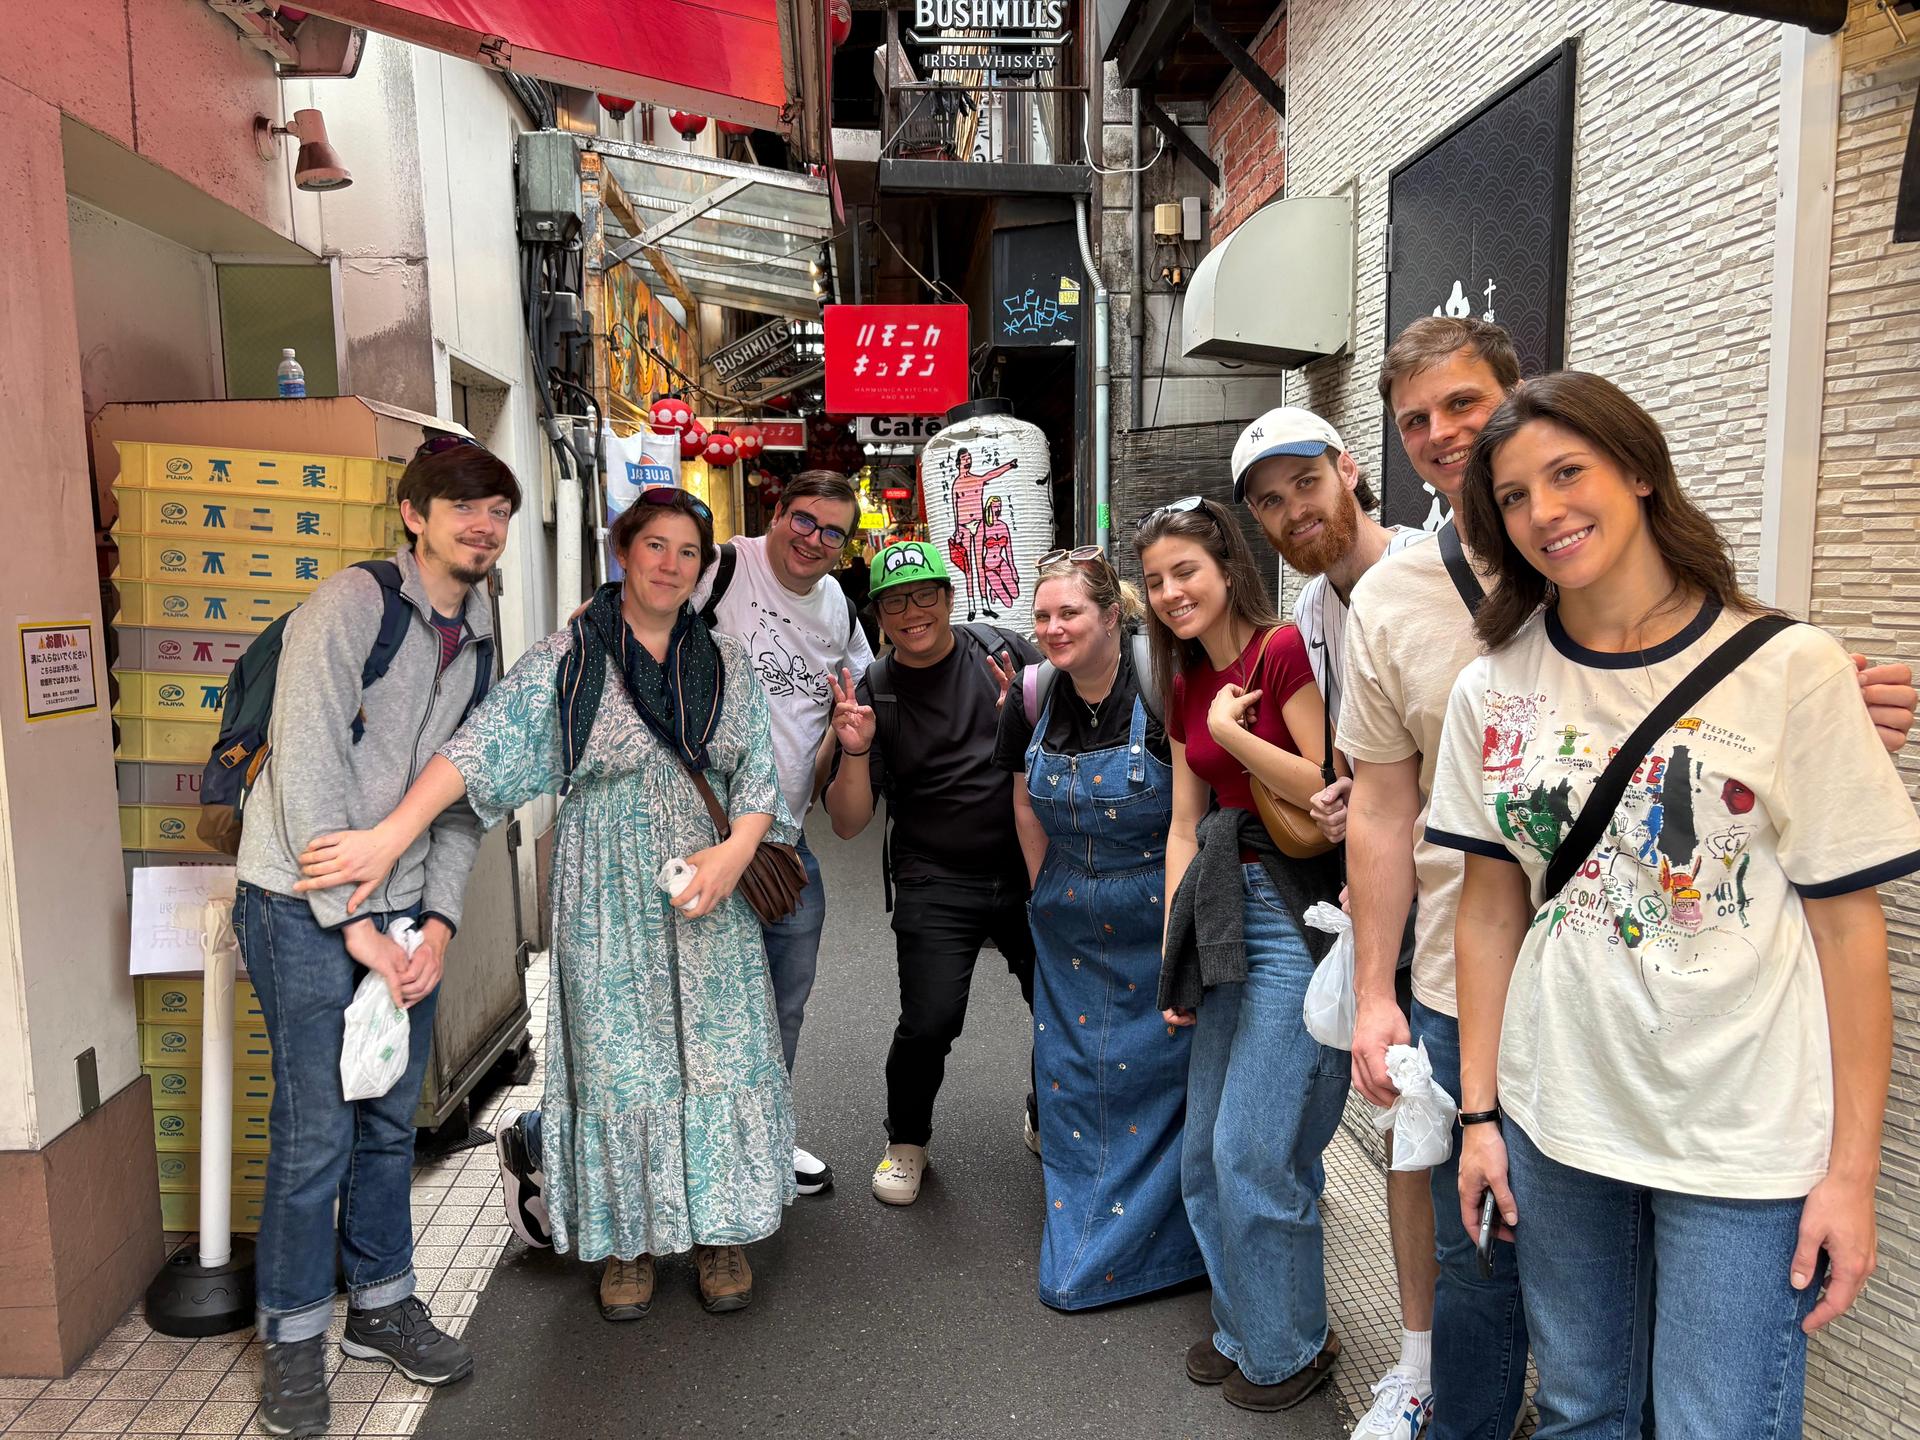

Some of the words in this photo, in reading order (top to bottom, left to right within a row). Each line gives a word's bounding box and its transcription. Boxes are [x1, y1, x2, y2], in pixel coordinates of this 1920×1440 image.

[916, 0, 1063, 28] BUSHMILLS
[924, 54, 970, 68] IRISH
[978, 54, 1057, 69] WHISKEY
[855, 324, 942, 347] ハモニカ
[713, 325, 789, 376] BUSHMILLS
[731, 375, 757, 393] IRISH
[756, 352, 796, 378] WHISKEY
[853, 354, 936, 377] キッチン
[870, 416, 943, 437] Café
[208, 458, 326, 489] 不二家
[160, 518, 188, 526] FUJIYA
[202, 504, 320, 536] 不二家
[159, 565, 187, 573] FUJIYA
[201, 551, 319, 581] 不二家
[203, 596, 300, 622] 不二
[45, 633, 71, 649] お願い
